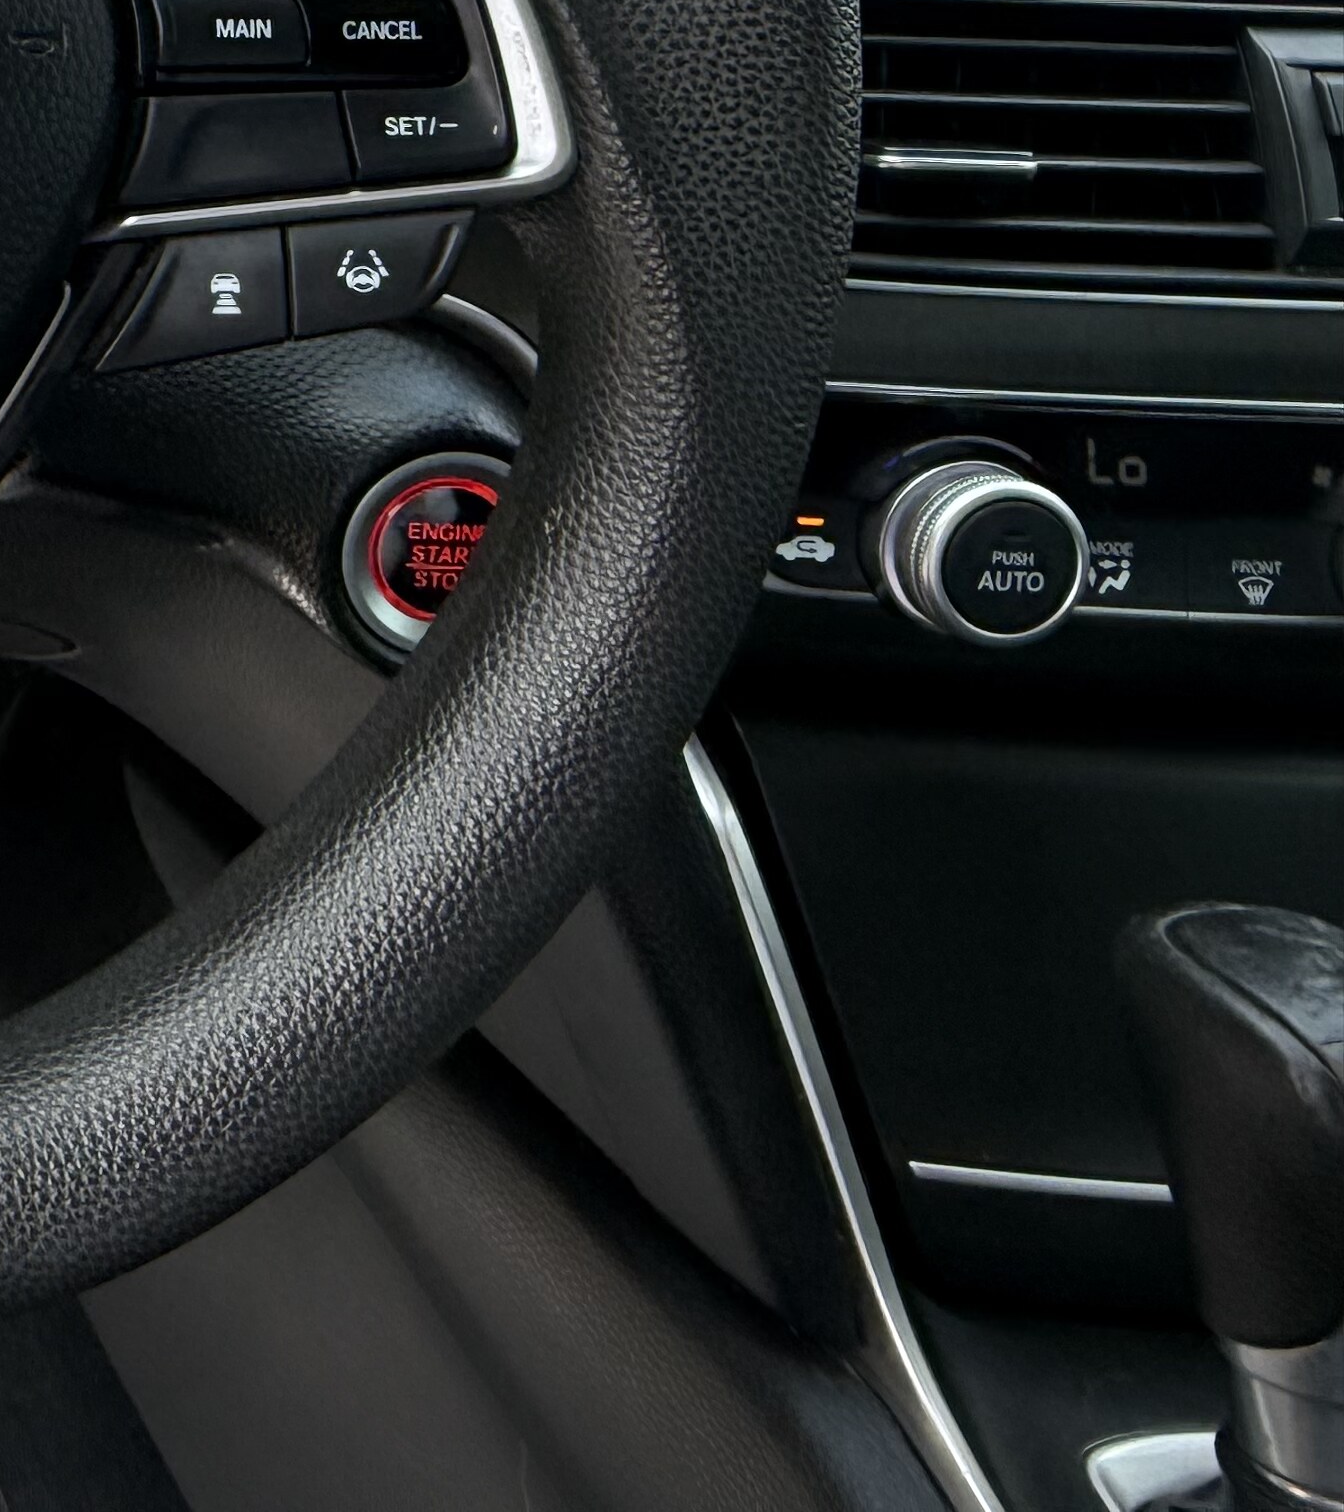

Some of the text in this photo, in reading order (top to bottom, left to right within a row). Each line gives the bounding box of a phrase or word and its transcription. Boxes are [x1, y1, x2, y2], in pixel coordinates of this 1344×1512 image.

[215, 18, 272, 40] MAIN
[342, 20, 423, 41] CANCEL
[411, 544, 474, 565] STAR
[992, 550, 1035, 566] PUSH
[413, 569, 460, 591] STO
[977, 570, 1045, 592] AUTO
